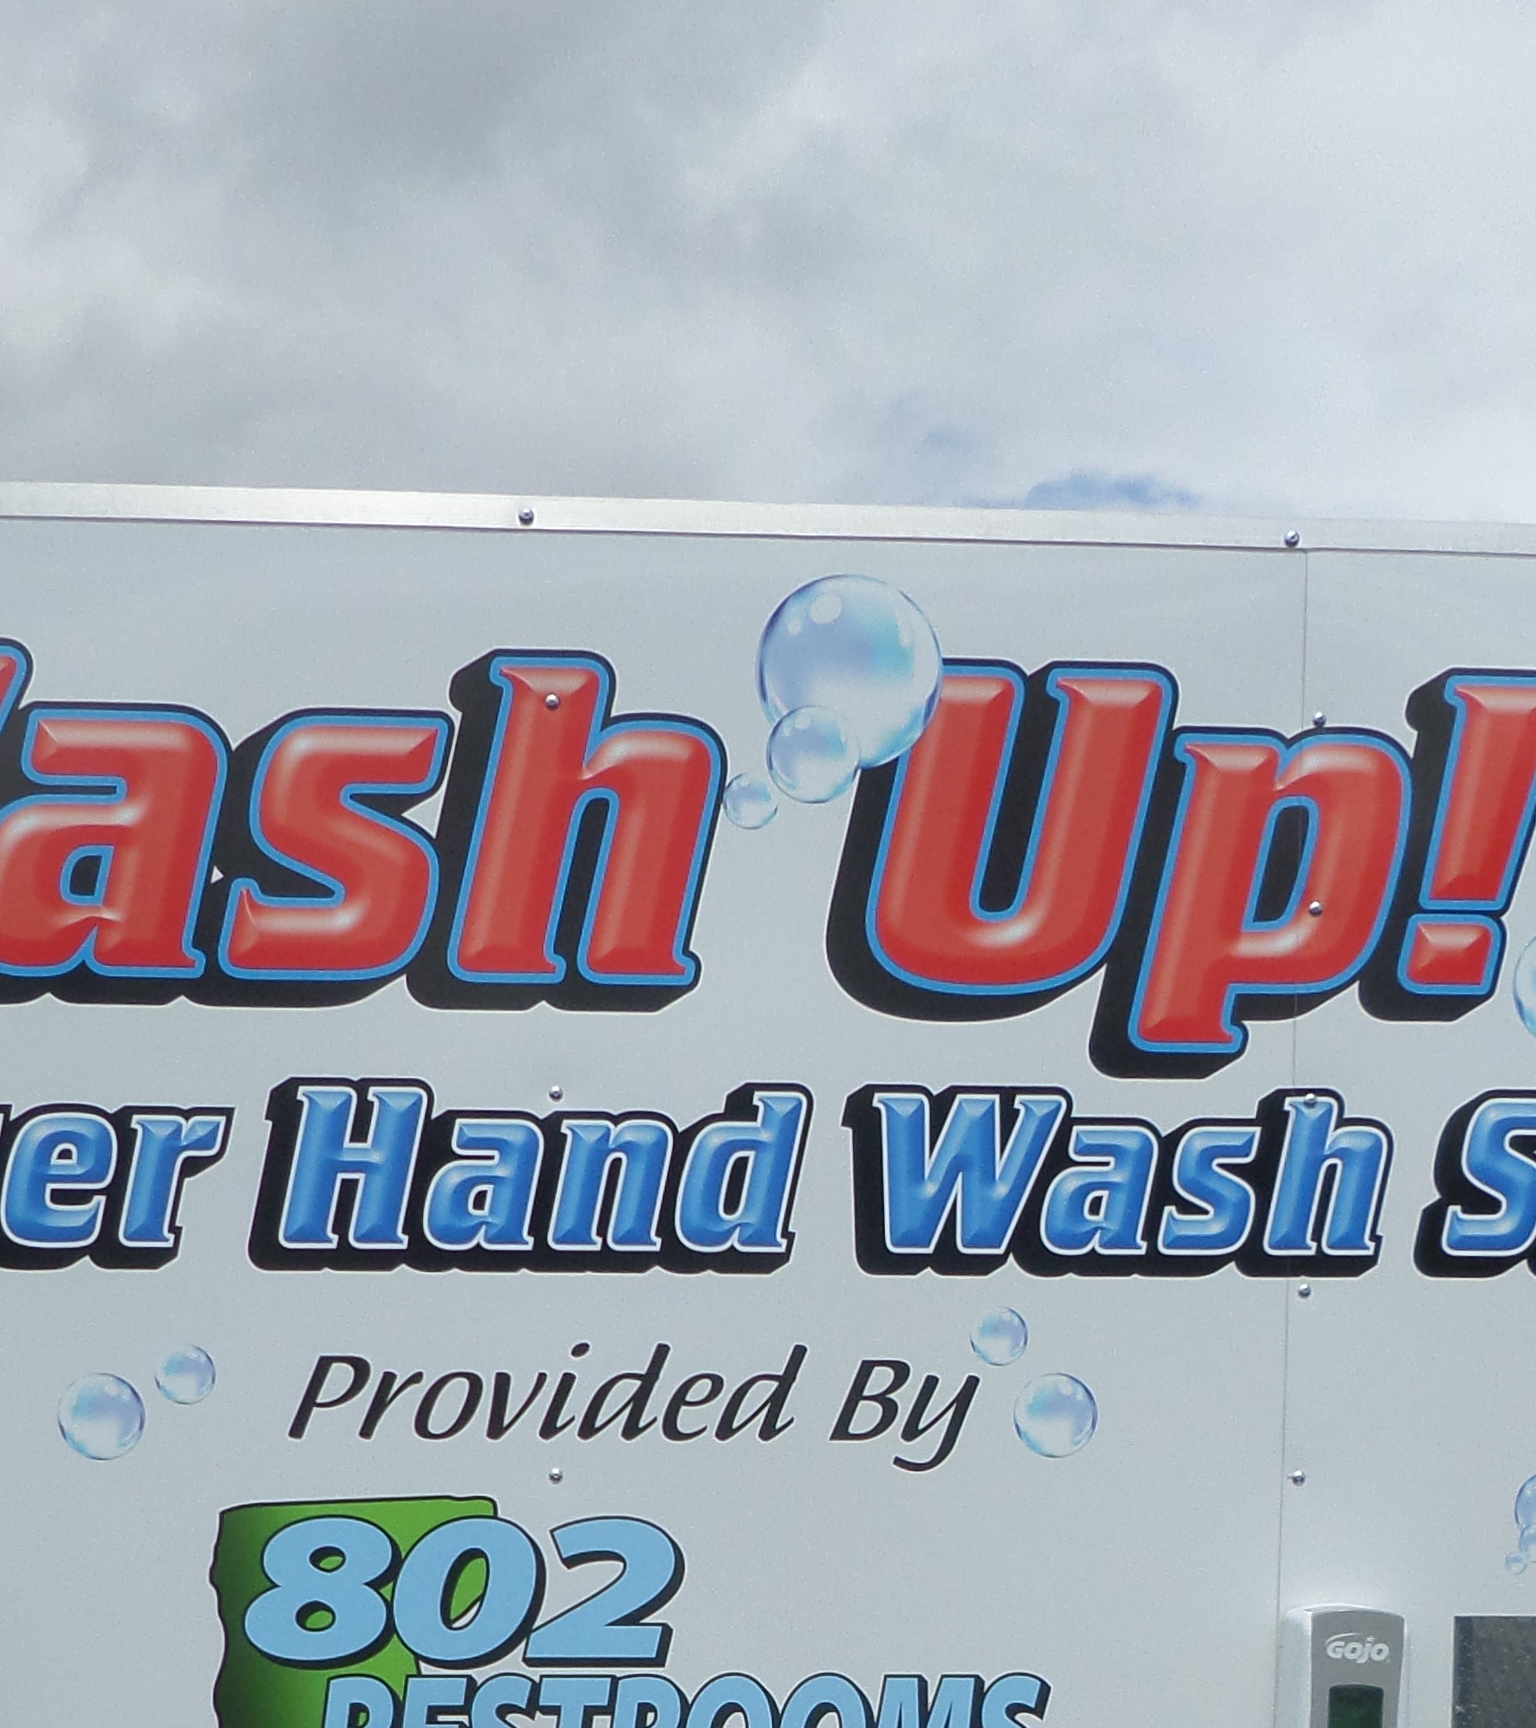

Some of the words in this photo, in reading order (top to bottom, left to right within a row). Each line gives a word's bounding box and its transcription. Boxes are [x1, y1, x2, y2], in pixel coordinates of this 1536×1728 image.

[248, 1076, 813, 1273] Hand
[842, 1082, 1394, 1280] Wash
[287, 1343, 808, 1441] Provided
[829, 1358, 981, 1472] By
[243, 1515, 684, 1669] 802
